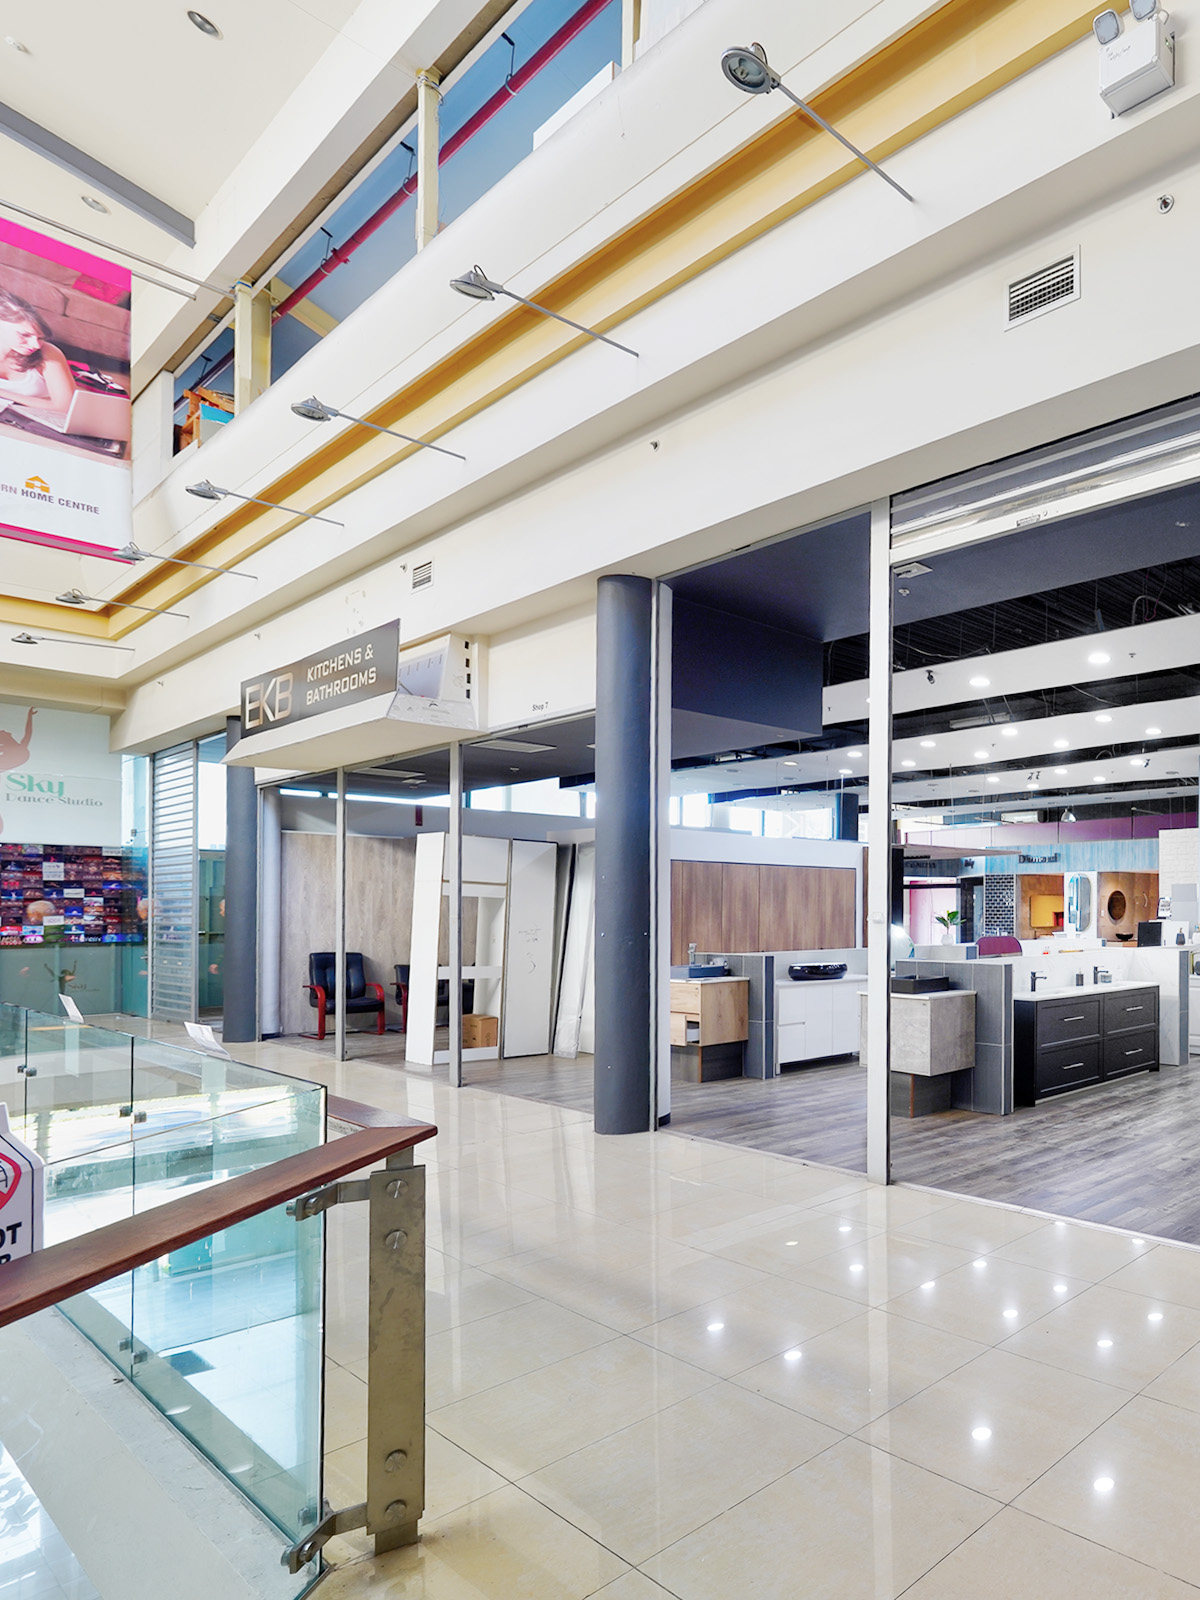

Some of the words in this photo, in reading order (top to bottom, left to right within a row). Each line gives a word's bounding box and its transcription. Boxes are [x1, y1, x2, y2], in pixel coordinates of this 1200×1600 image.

[21, 488, 54, 503] HOME
[58, 498, 100, 515] CENTRE
[306, 648, 362, 683] KITCHENS
[364, 643, 374, 660] &
[245, 672, 293, 730] EKB
[306, 667, 377, 706] BATHROOMS
[6, 773, 65, 798] Sky
[6, 793, 55, 804] Dance
[58, 797, 103, 807] Studio
